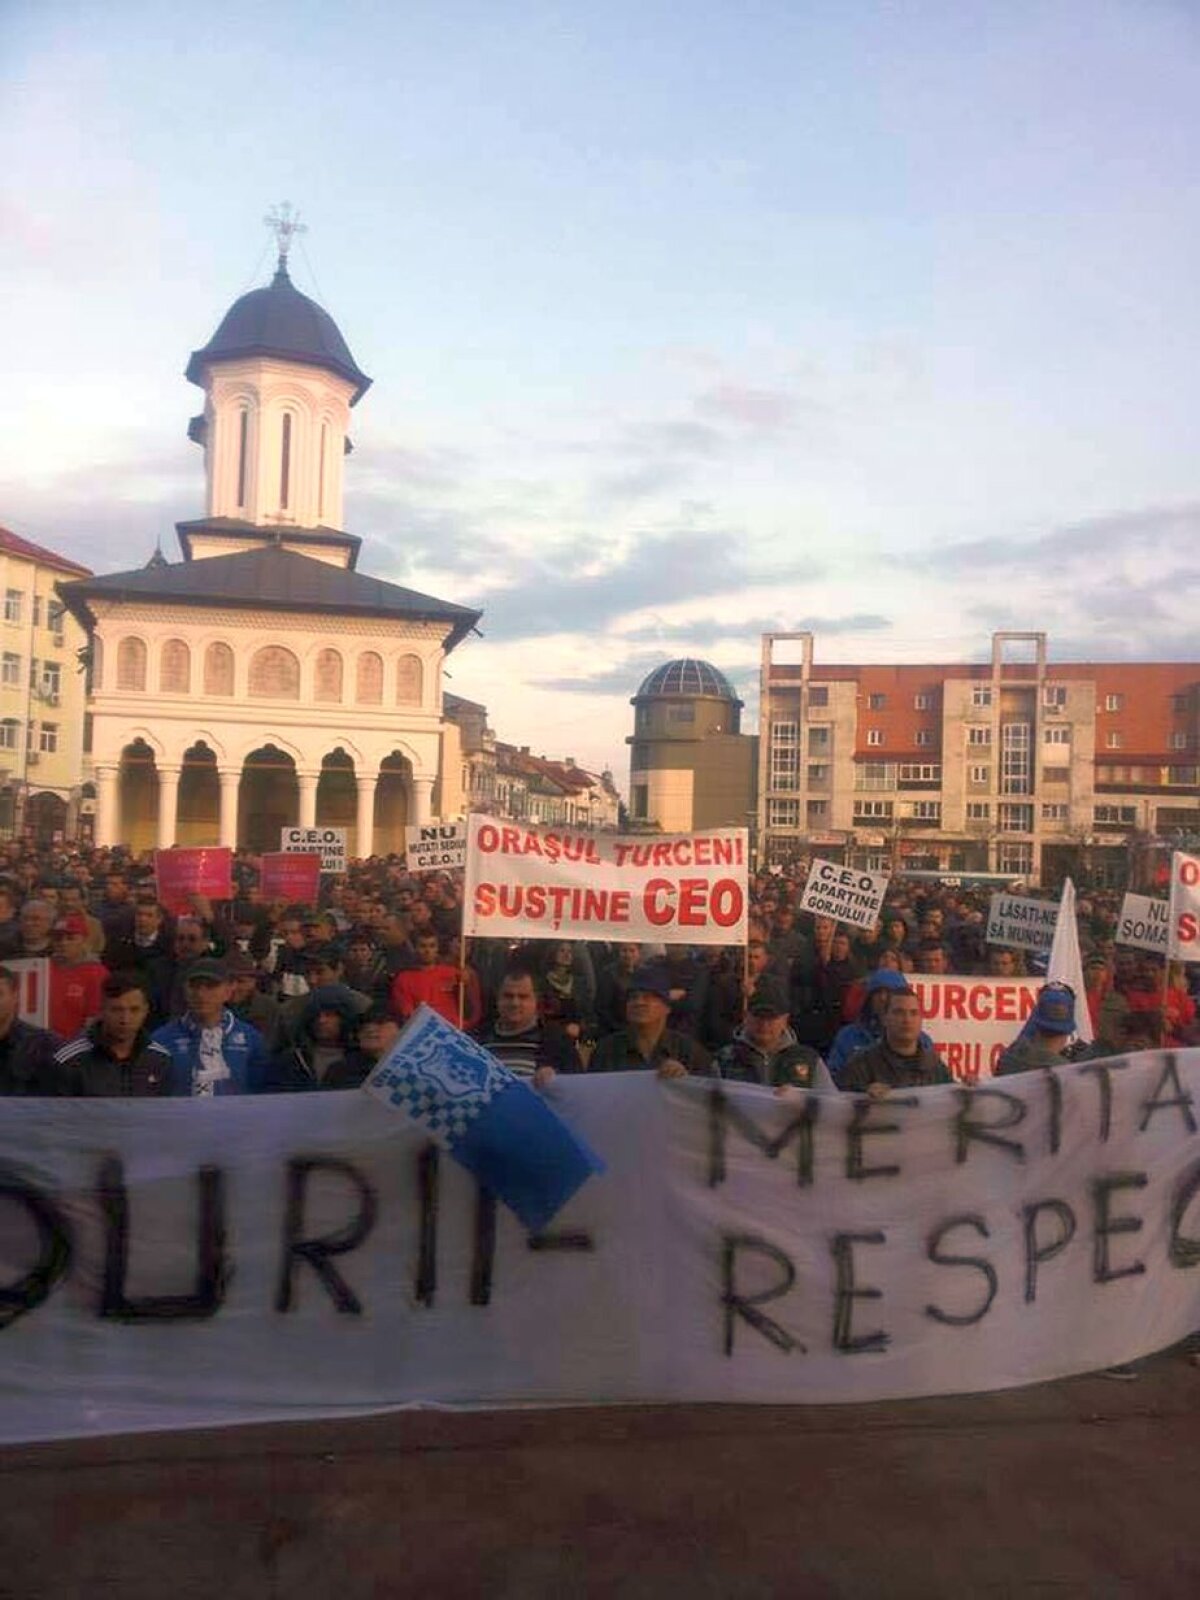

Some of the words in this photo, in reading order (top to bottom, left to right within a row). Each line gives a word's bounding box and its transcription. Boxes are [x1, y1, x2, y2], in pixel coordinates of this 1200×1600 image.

[290, 830, 341, 843] C.E.O.
[421, 826, 456, 840] NU
[613, 836, 744, 867] TURCENI
[820, 865, 877, 894] C.E.O.
[643, 878, 744, 927] CEO
[1148, 901, 1170, 922] NU
